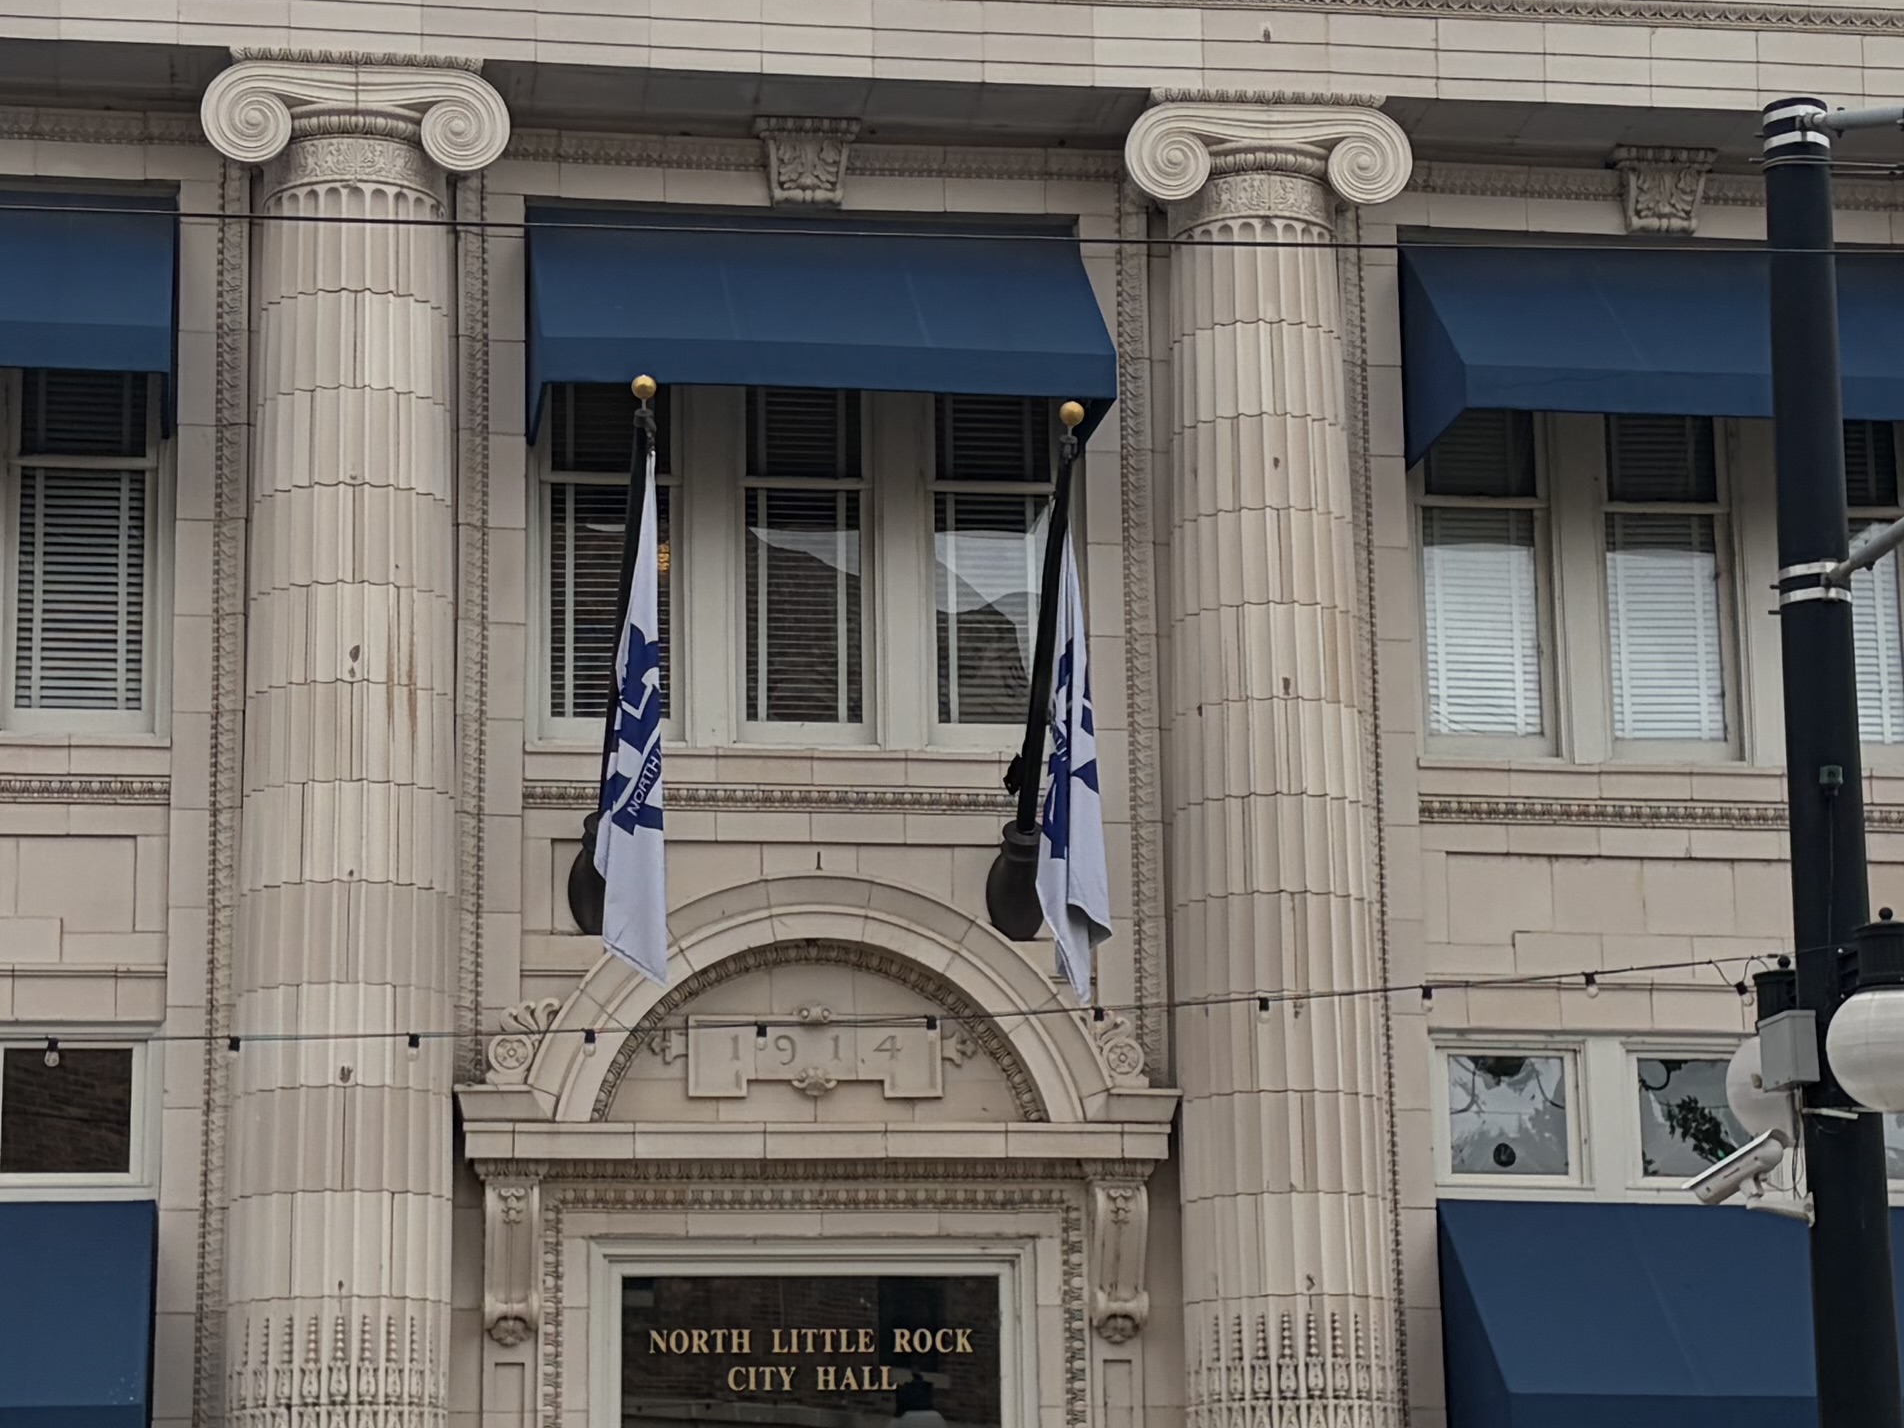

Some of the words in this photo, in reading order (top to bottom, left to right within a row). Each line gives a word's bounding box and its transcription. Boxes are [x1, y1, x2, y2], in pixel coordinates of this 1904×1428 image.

[626, 755, 662, 817] NORTH
[648, 1328, 752, 1354] NORTH
[772, 1328, 875, 1354] LITTLE
[893, 1328, 974, 1354] ROCK
[727, 1366, 797, 1391] CITY
[816, 1366, 898, 1391] HALL
